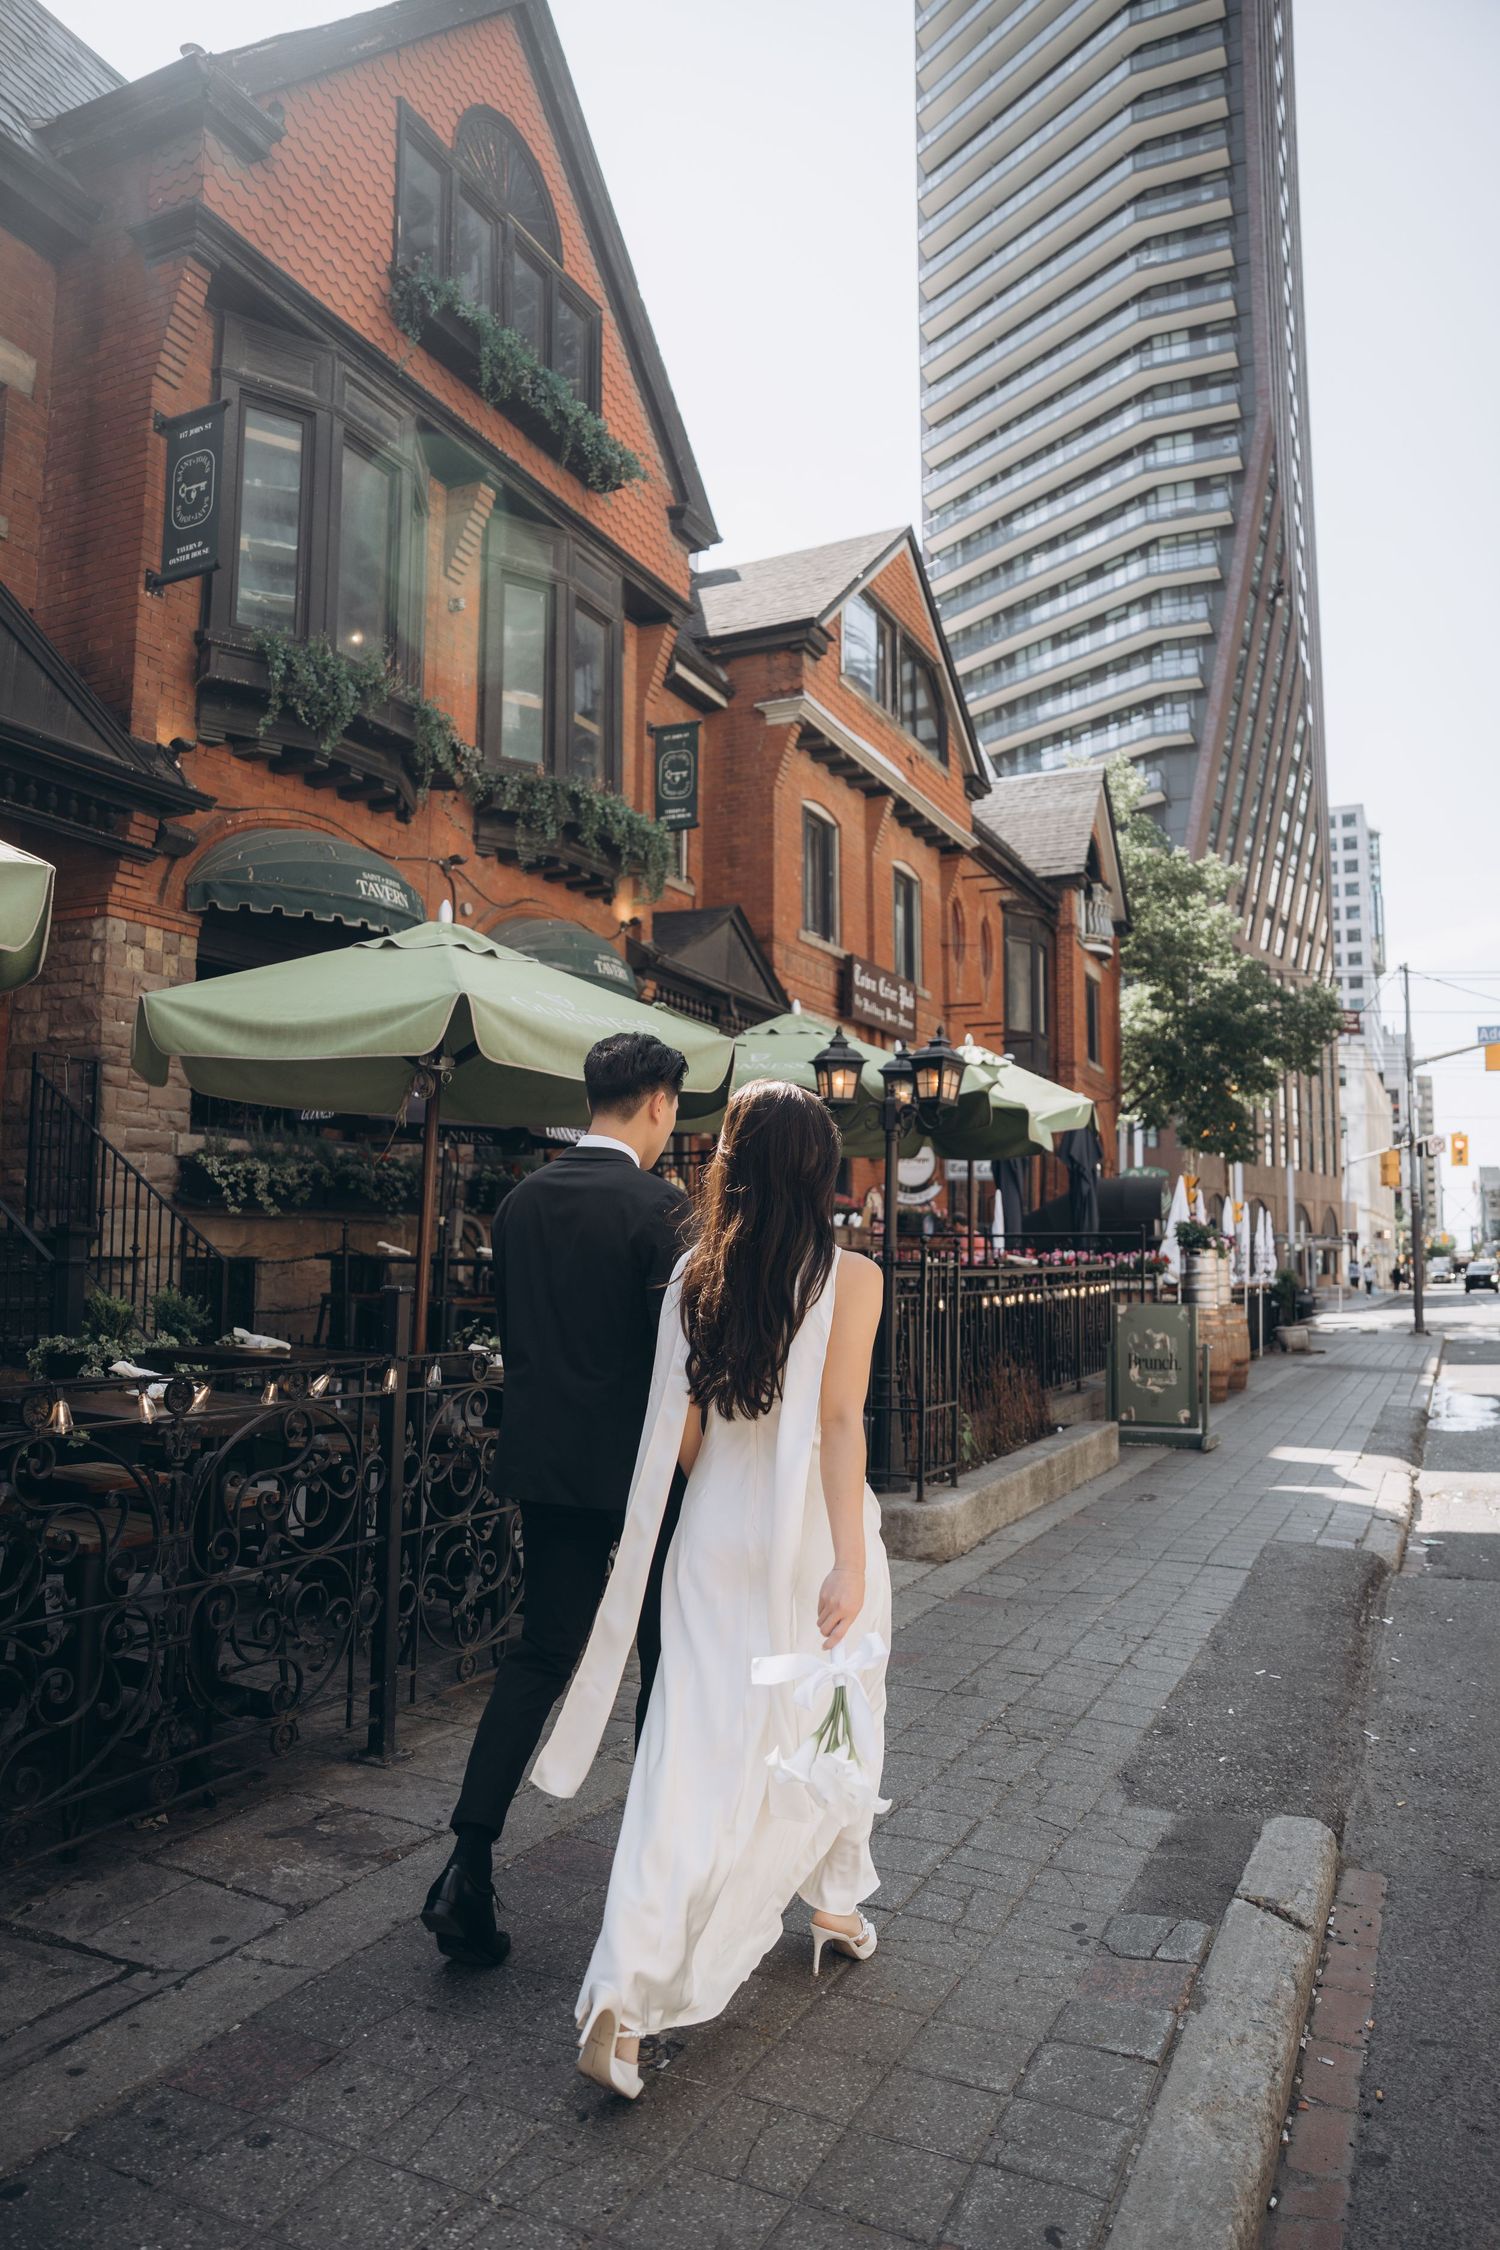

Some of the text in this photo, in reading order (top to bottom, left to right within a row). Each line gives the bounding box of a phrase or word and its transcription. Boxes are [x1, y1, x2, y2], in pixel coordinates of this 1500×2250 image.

[356, 879, 409, 910] TAVERN
[593, 959, 629, 982] TAVERN
[1480, 1028, 1500, 1041] Ad
[1127, 1352, 1182, 1371] Brunch.
